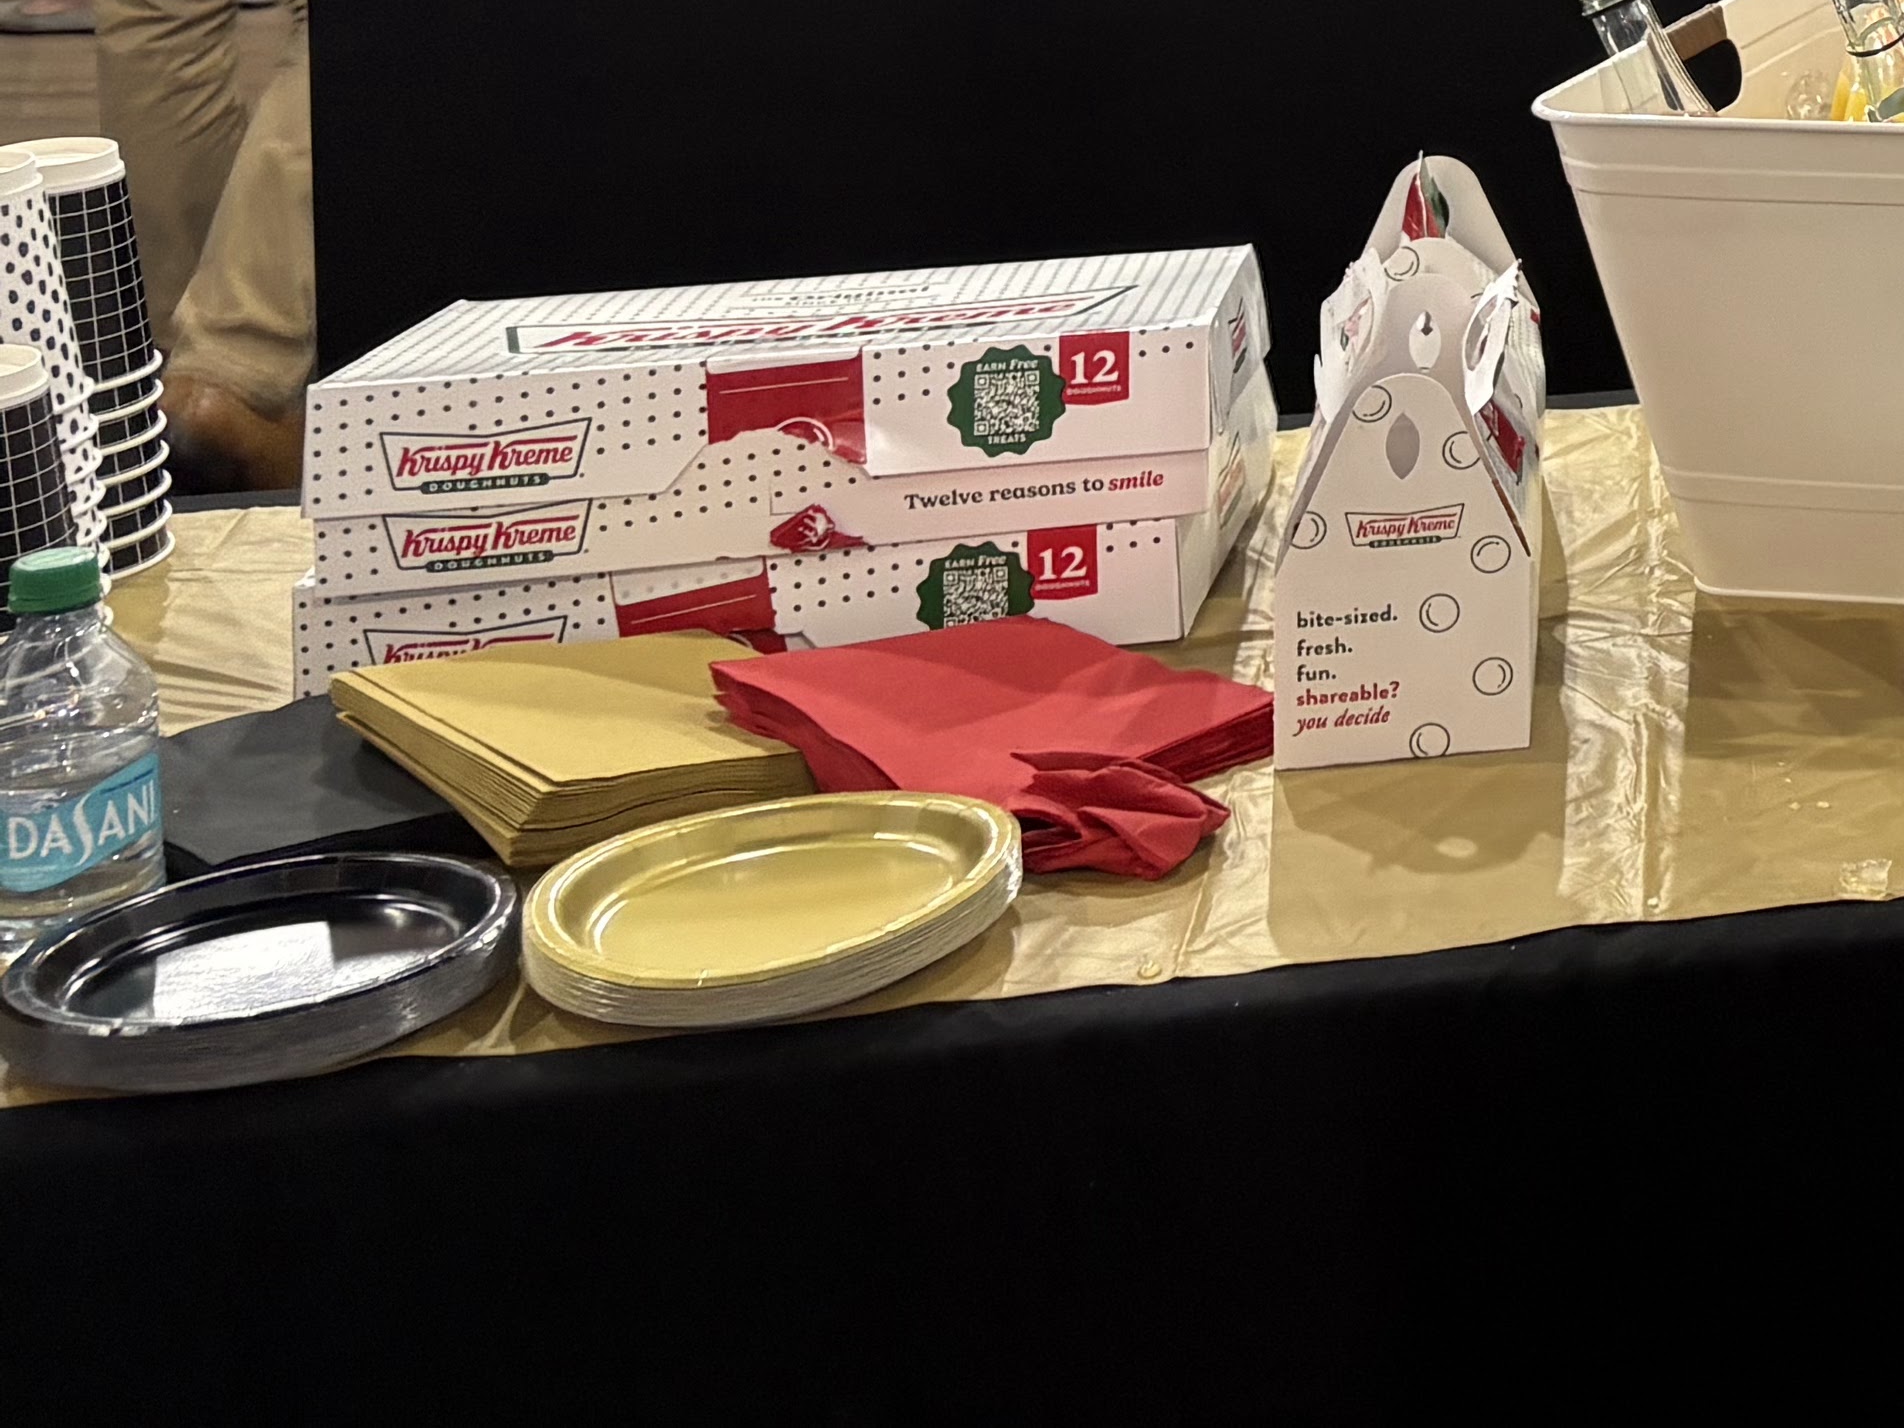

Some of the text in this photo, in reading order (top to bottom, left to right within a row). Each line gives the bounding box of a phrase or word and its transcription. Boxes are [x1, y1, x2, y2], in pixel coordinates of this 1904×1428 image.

[976, 359, 1038, 372] EARN Free
[1070, 350, 1119, 385] 12
[988, 434, 1026, 444] TREATS
[396, 435, 578, 477] Krispy Kreme
[429, 475, 541, 492] DOUGHNUTS
[904, 470, 1164, 511] Twelve reasons to smile
[401, 514, 580, 558] Krispy Kreme
[1356, 513, 1457, 539] Krispy Kreme
[434, 552, 545, 571] DOUGHNUTS
[1038, 546, 1087, 581] 12
[1297, 604, 1398, 628] bite-sized.
[1297, 637, 1353, 657] fresh.
[1297, 664, 1337, 682] fun.
[1296, 681, 1400, 706] shareable?
[1292, 705, 1391, 737] you decide
[8, 779, 156, 867] DASANI
